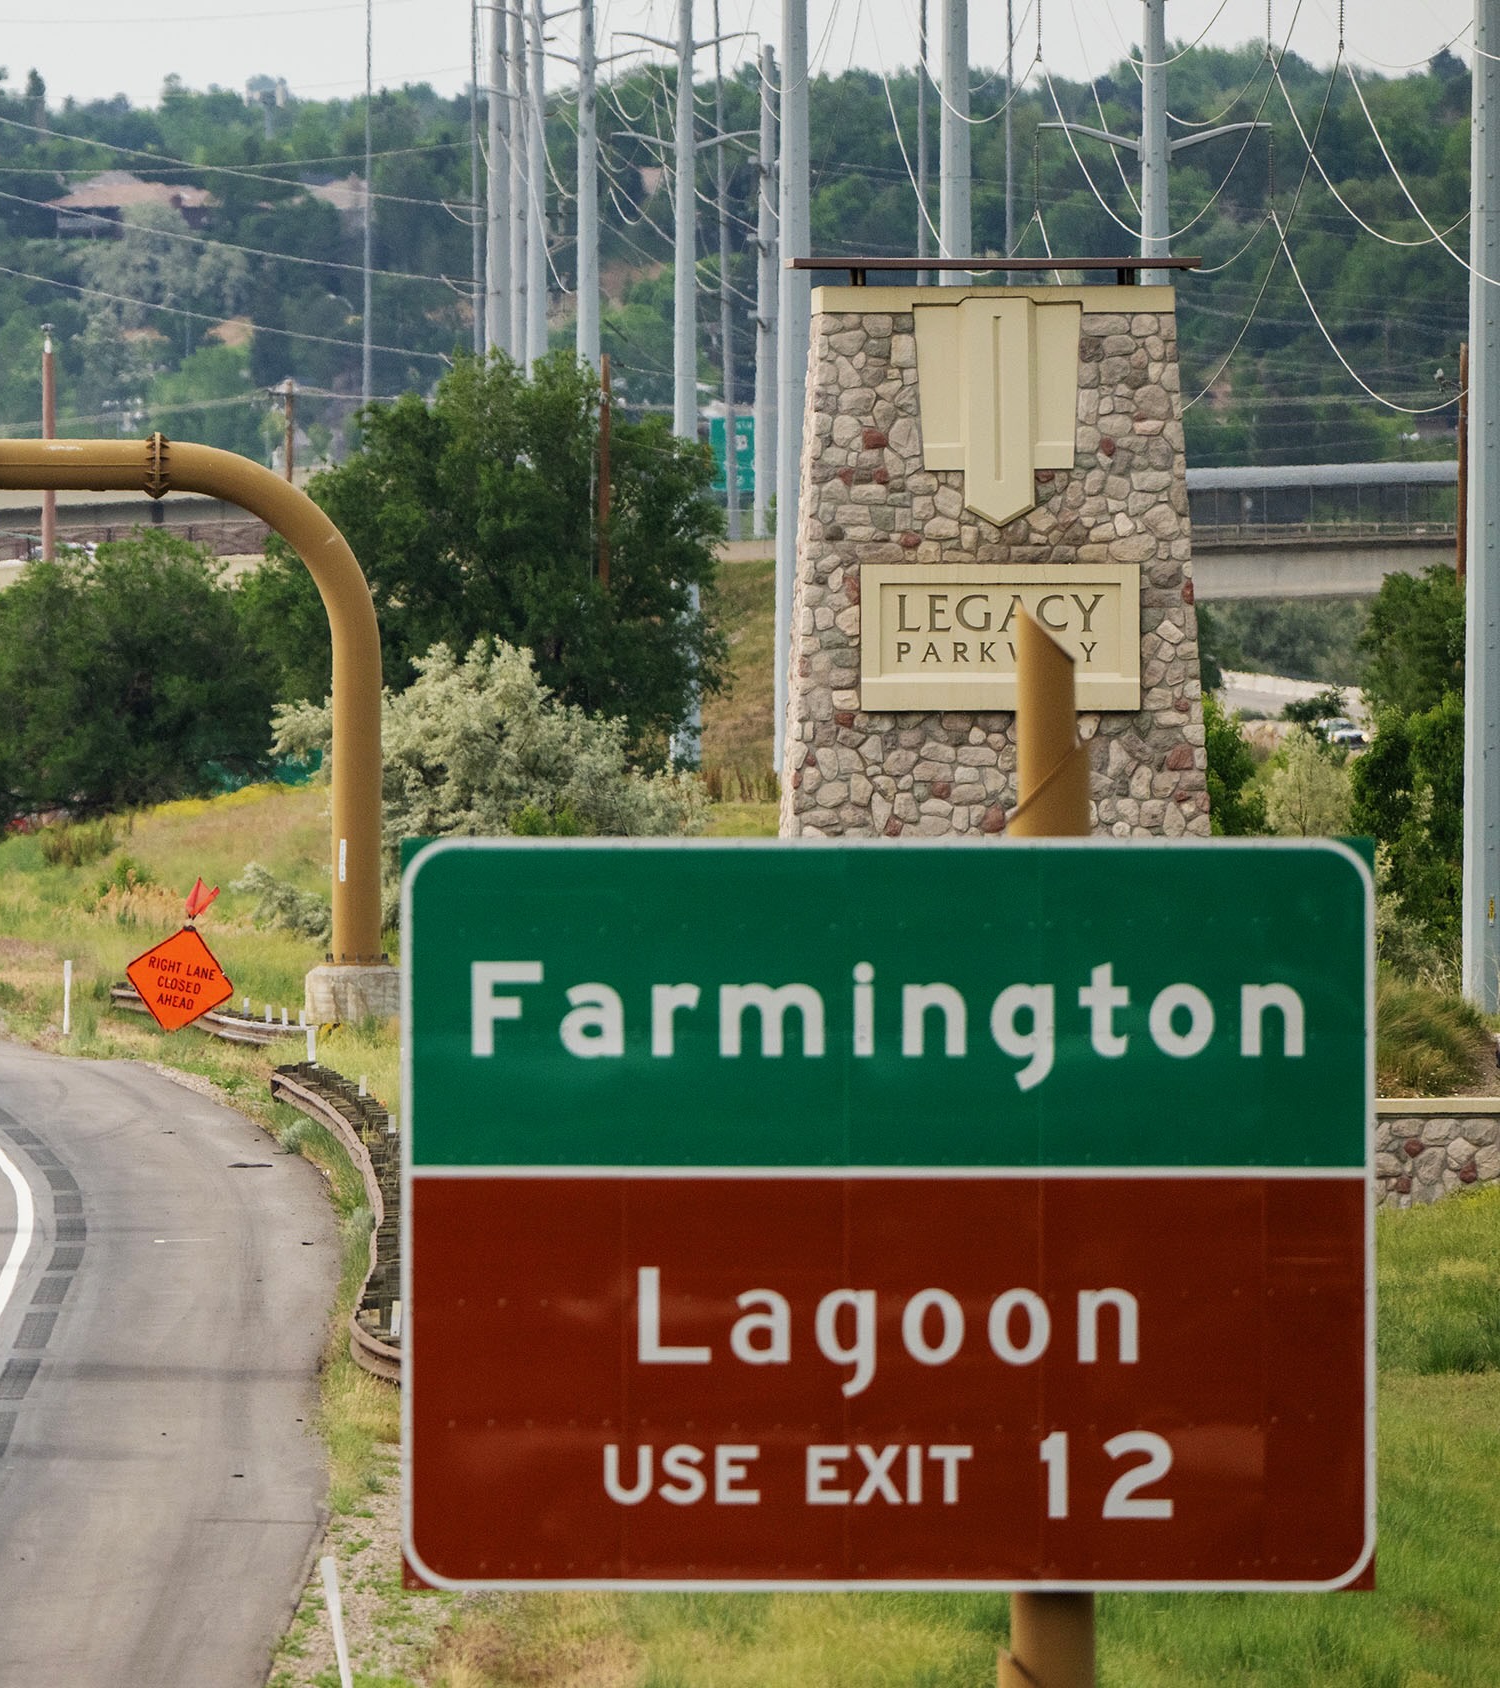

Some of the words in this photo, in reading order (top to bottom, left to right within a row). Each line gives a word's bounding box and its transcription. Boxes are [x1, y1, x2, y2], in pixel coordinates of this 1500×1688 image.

[896, 641, 1098, 663] PARKY
[148, 956, 182, 973] RIGHT
[186, 964, 216, 981] LANE
[157, 975, 201, 995] CLOSED
[156, 993, 194, 1011] AHEAD
[470, 960, 1306, 1092] Farmington
[637, 1266, 1140, 1398] Lagoon
[602, 1444, 761, 1505] USE
[804, 1444, 973, 1505] EXIT
[1040, 1431, 1174, 1520] 12
